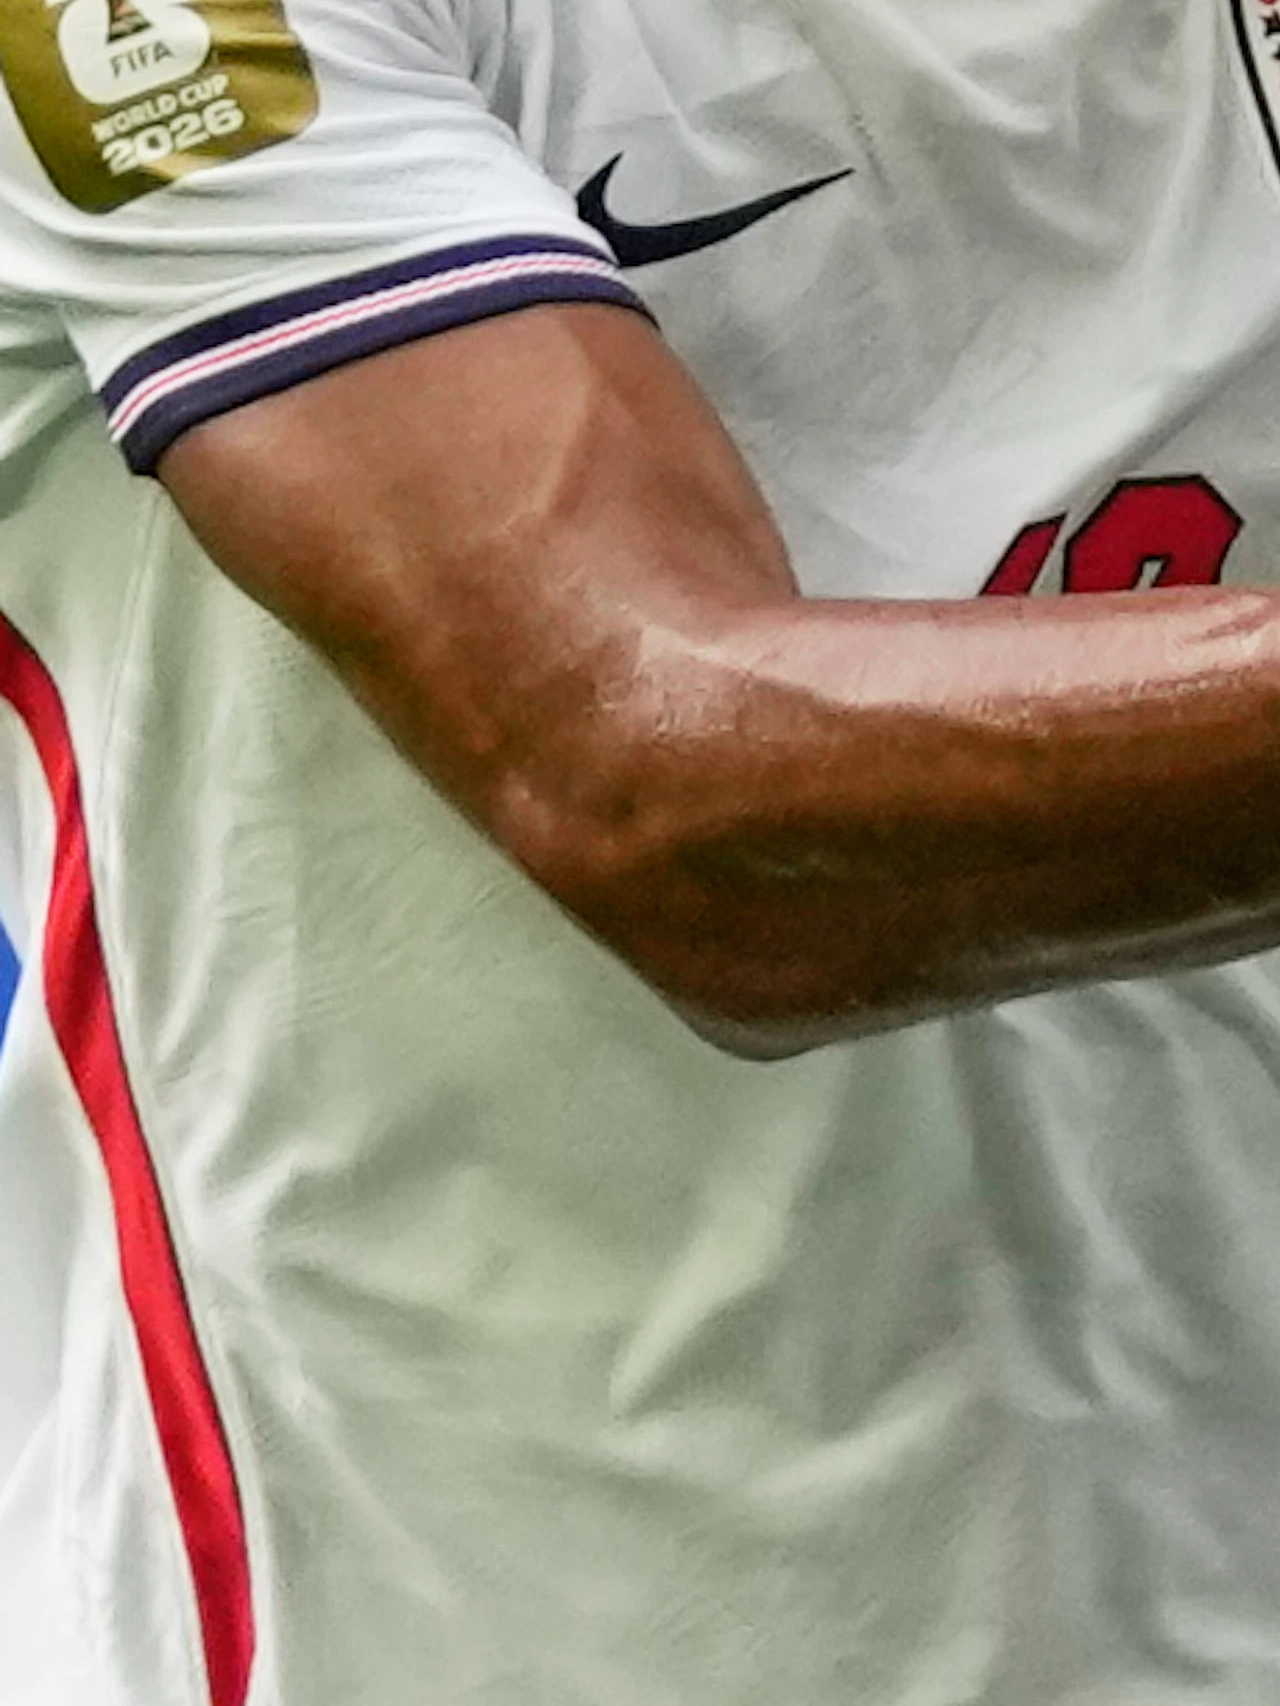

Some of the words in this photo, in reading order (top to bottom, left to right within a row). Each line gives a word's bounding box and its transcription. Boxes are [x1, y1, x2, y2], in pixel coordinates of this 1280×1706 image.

[108, 40, 175, 78] FIFA
[91, 96, 178, 144] WORLD
[176, 74, 229, 109] CUP
[101, 98, 246, 177] 2026
